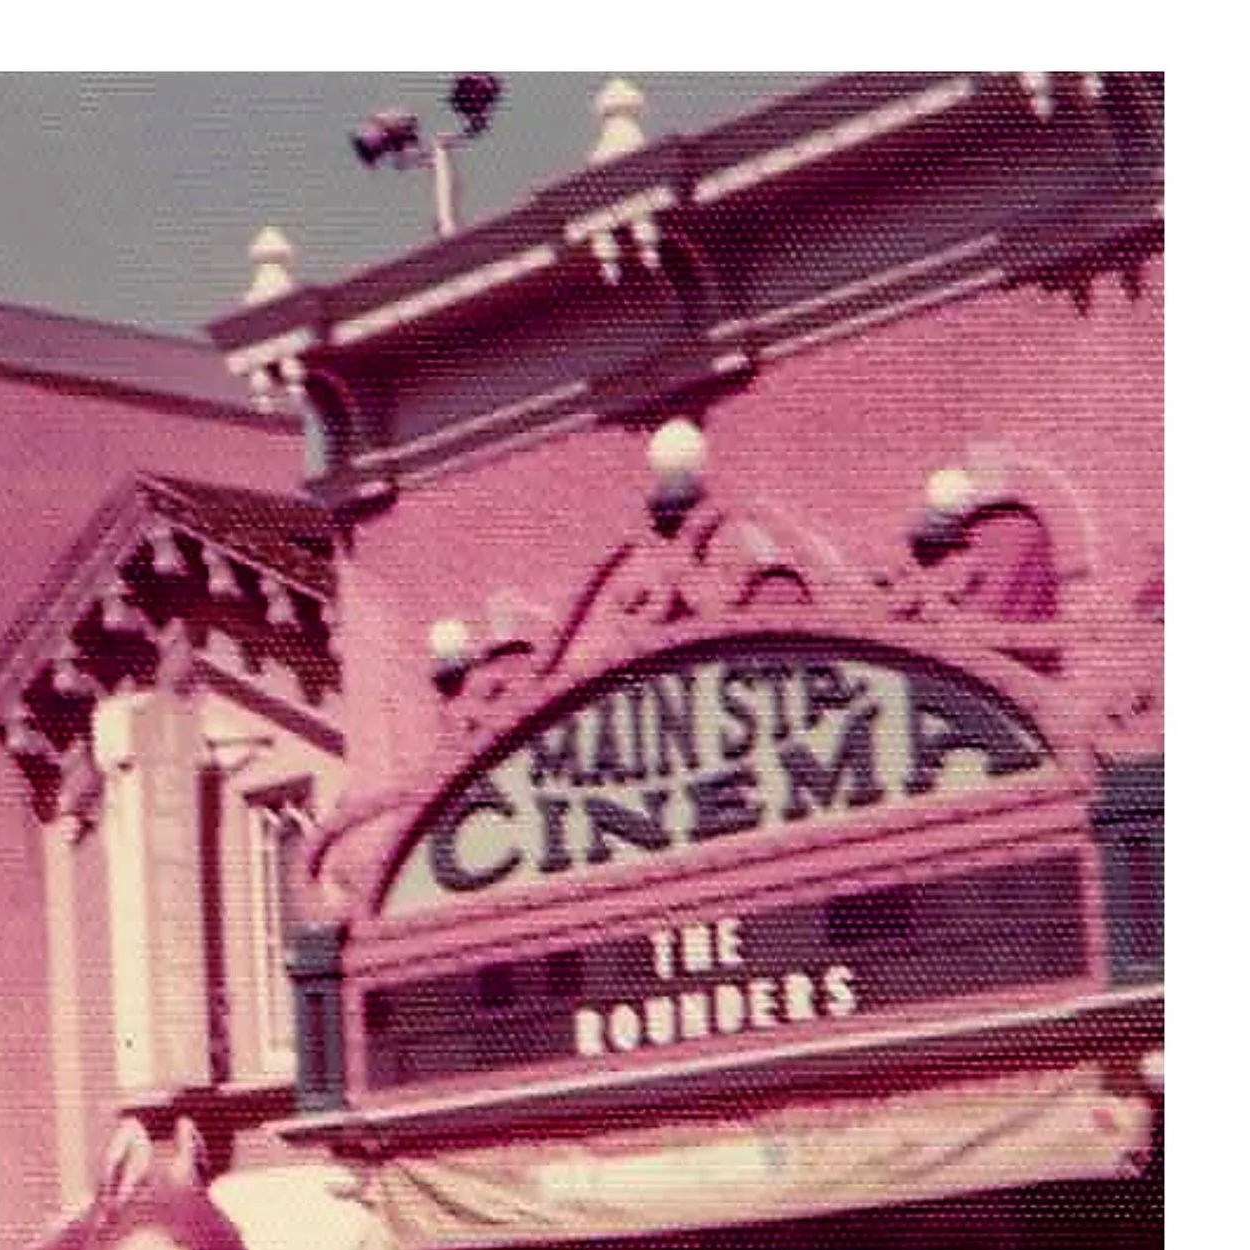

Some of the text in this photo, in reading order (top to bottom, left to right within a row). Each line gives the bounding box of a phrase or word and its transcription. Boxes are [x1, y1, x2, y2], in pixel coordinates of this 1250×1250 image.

[530, 670, 700, 786] MAIN
[432, 668, 1046, 893] CINEMA
[652, 918, 743, 980] THE
[575, 965, 856, 1057] ROUNDERS
